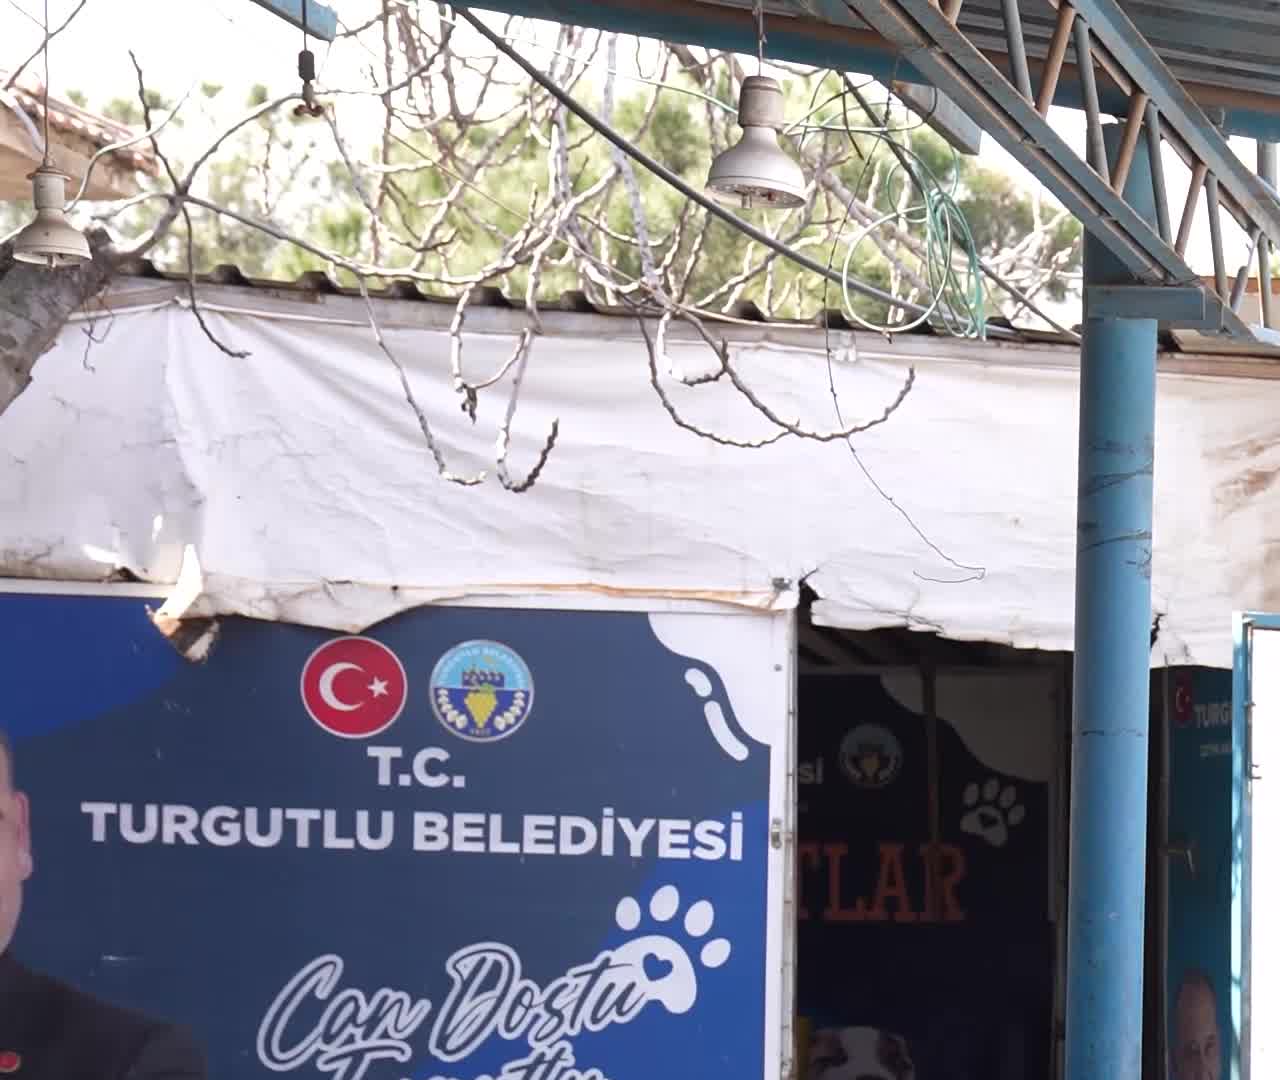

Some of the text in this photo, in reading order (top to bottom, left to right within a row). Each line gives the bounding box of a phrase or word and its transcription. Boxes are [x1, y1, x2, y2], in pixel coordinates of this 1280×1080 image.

[367, 746, 466, 788] T.C.
[80, 801, 744, 861] TURGUTLU BELEDİYESİ
[256, 942, 650, 1071] Can Dostu
